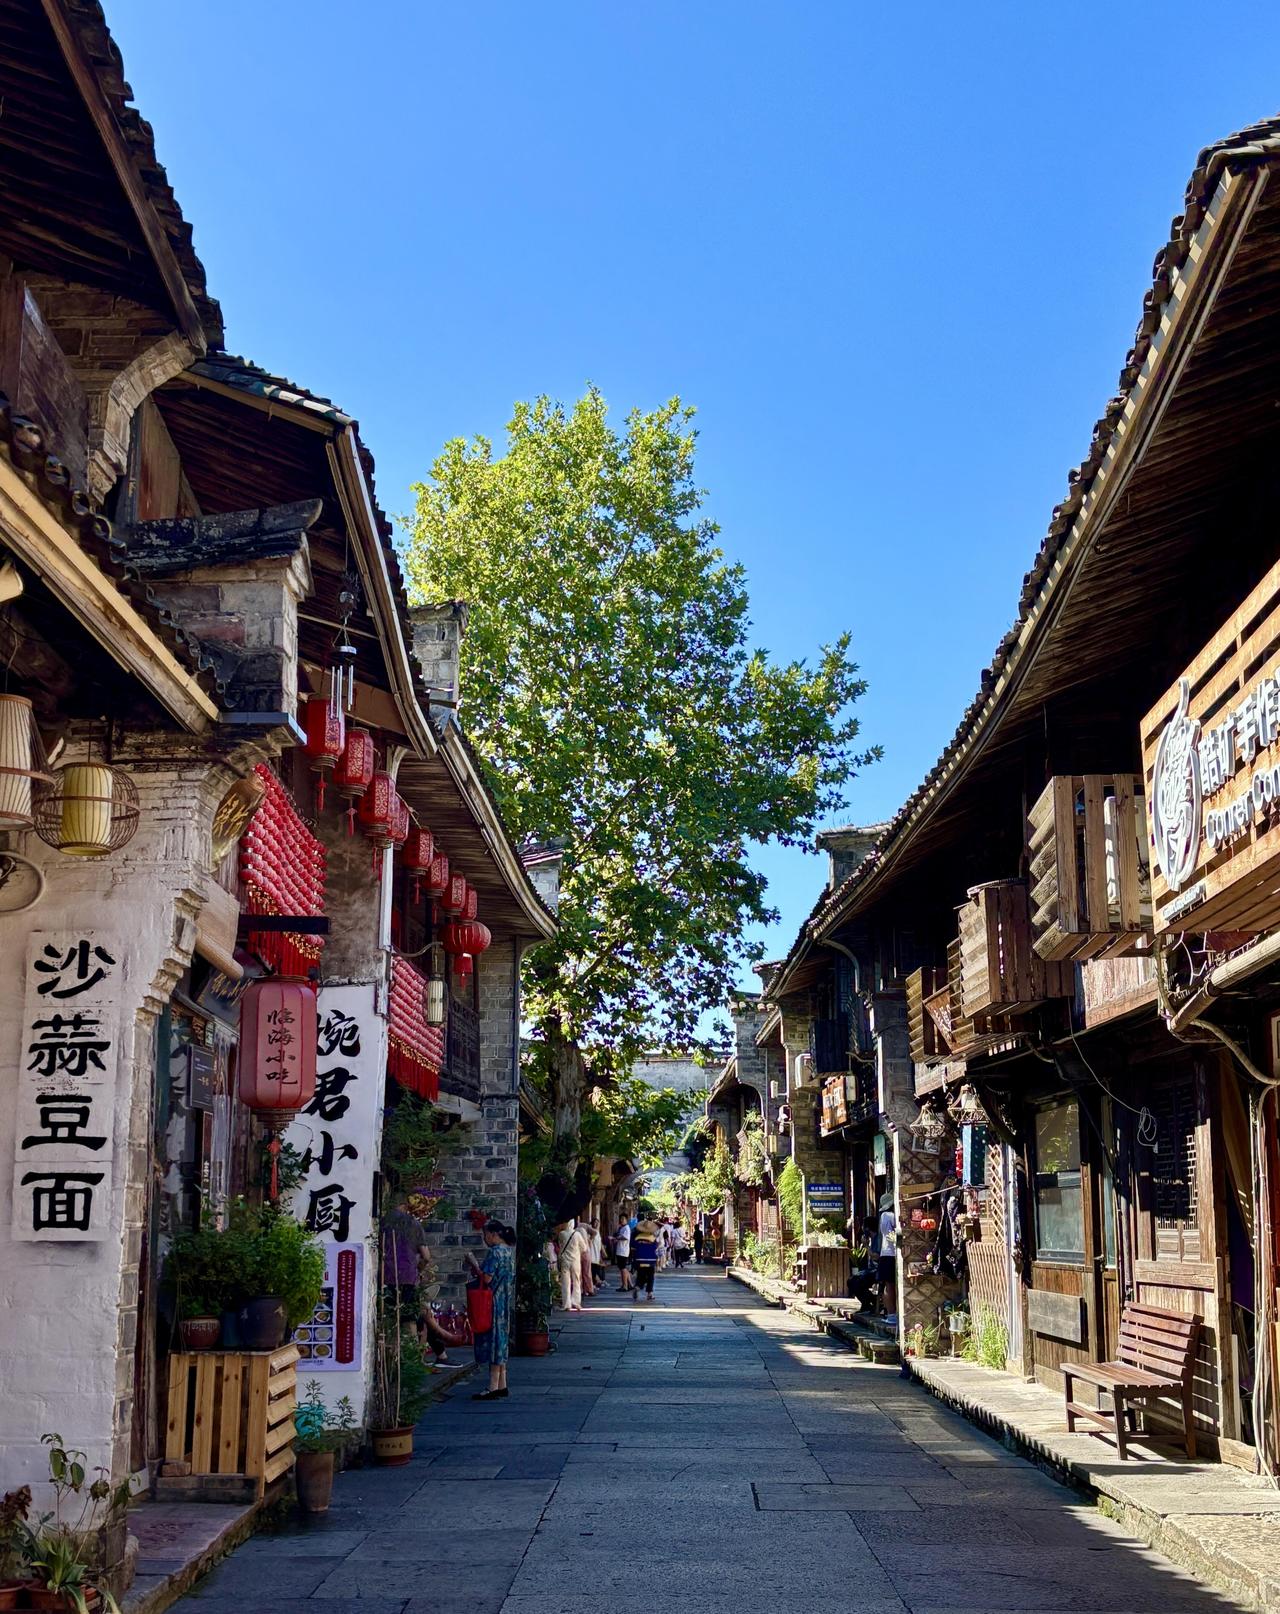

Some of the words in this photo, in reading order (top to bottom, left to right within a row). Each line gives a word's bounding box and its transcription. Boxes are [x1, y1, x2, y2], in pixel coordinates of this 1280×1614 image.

[1198, 667, 1280, 796] 酷矿手作
[21, 939, 116, 1231] 沙蒜豆面
[265, 1007, 298, 1085] 临海小吃
